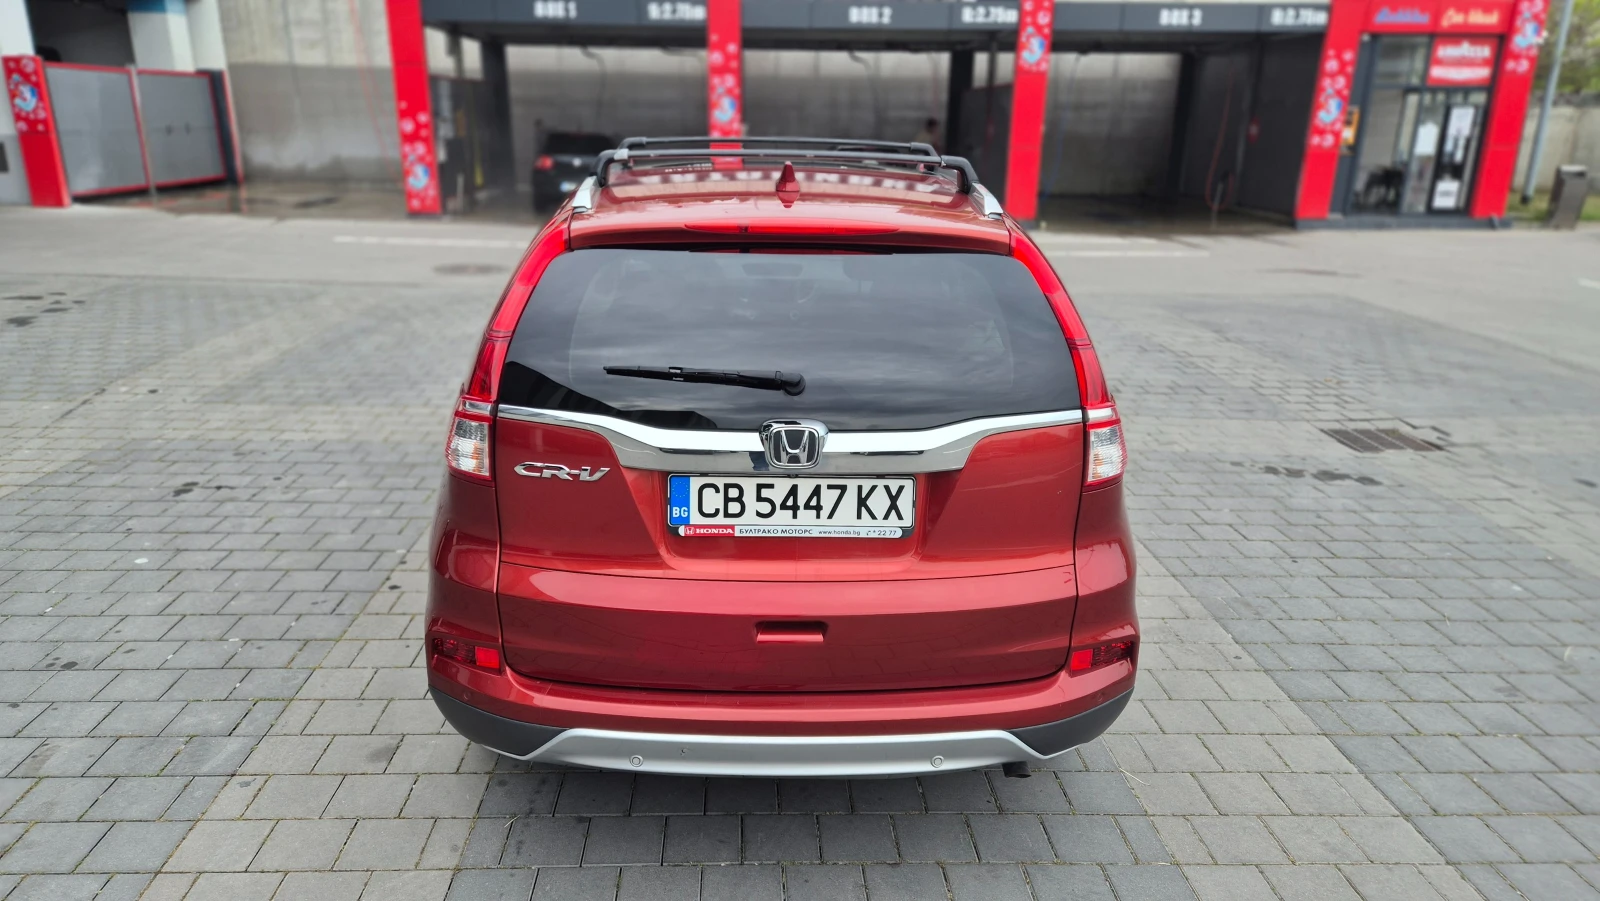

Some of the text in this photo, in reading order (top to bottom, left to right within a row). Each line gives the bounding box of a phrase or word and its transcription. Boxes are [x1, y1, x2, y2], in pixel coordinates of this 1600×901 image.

[514, 462, 611, 482] CR-V
[697, 483, 905, 520] CB 5447 KX
[672, 507, 688, 517] BG
[818, 528, 860, 536] www.honda.bg
